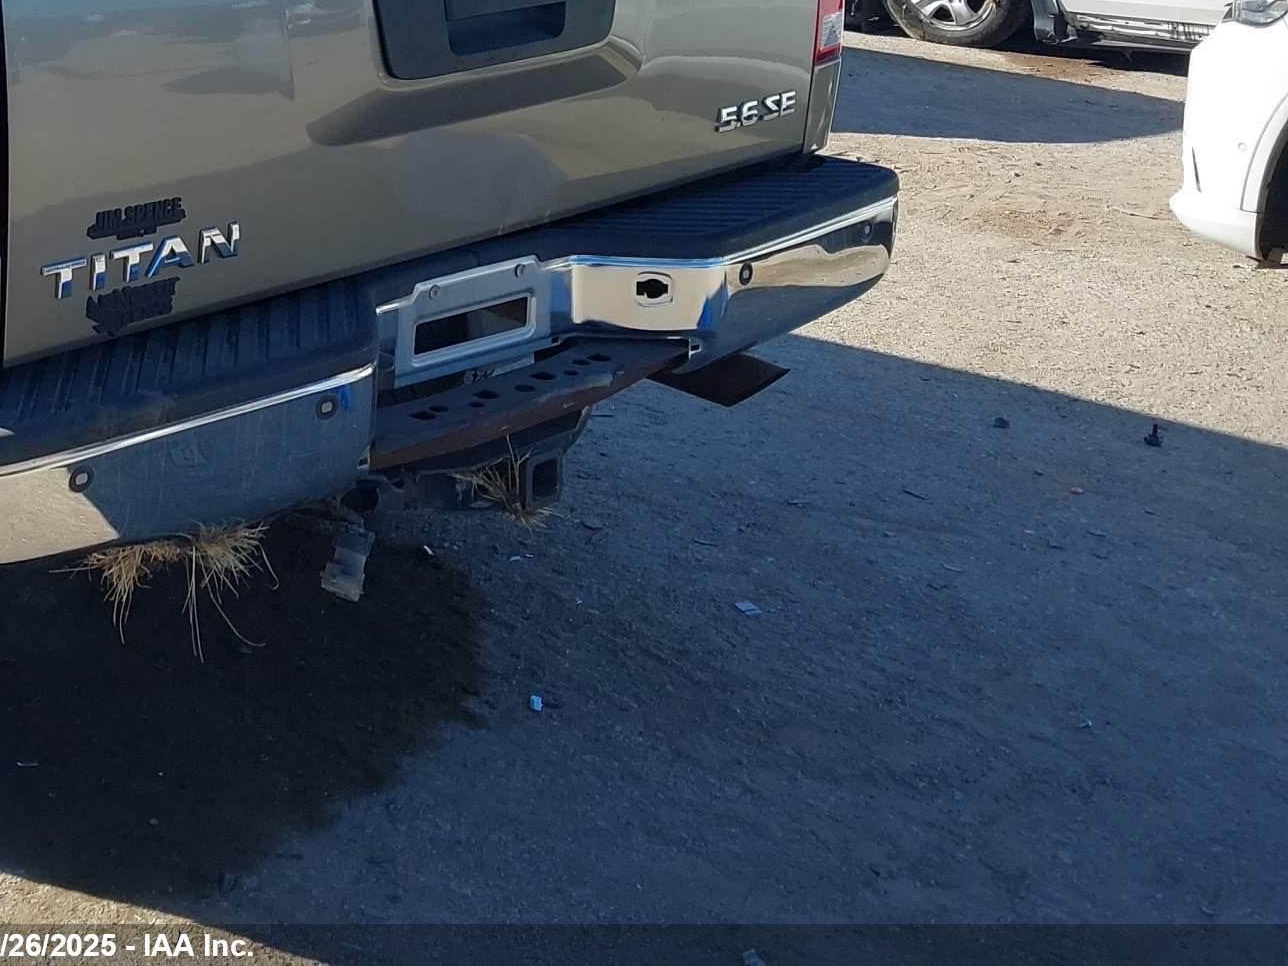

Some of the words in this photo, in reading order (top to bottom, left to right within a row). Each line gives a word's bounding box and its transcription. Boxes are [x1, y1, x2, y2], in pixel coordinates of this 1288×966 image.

[715, 100, 759, 134] 5.6
[761, 89, 797, 121] SE
[40, 220, 241, 300] TITAN
